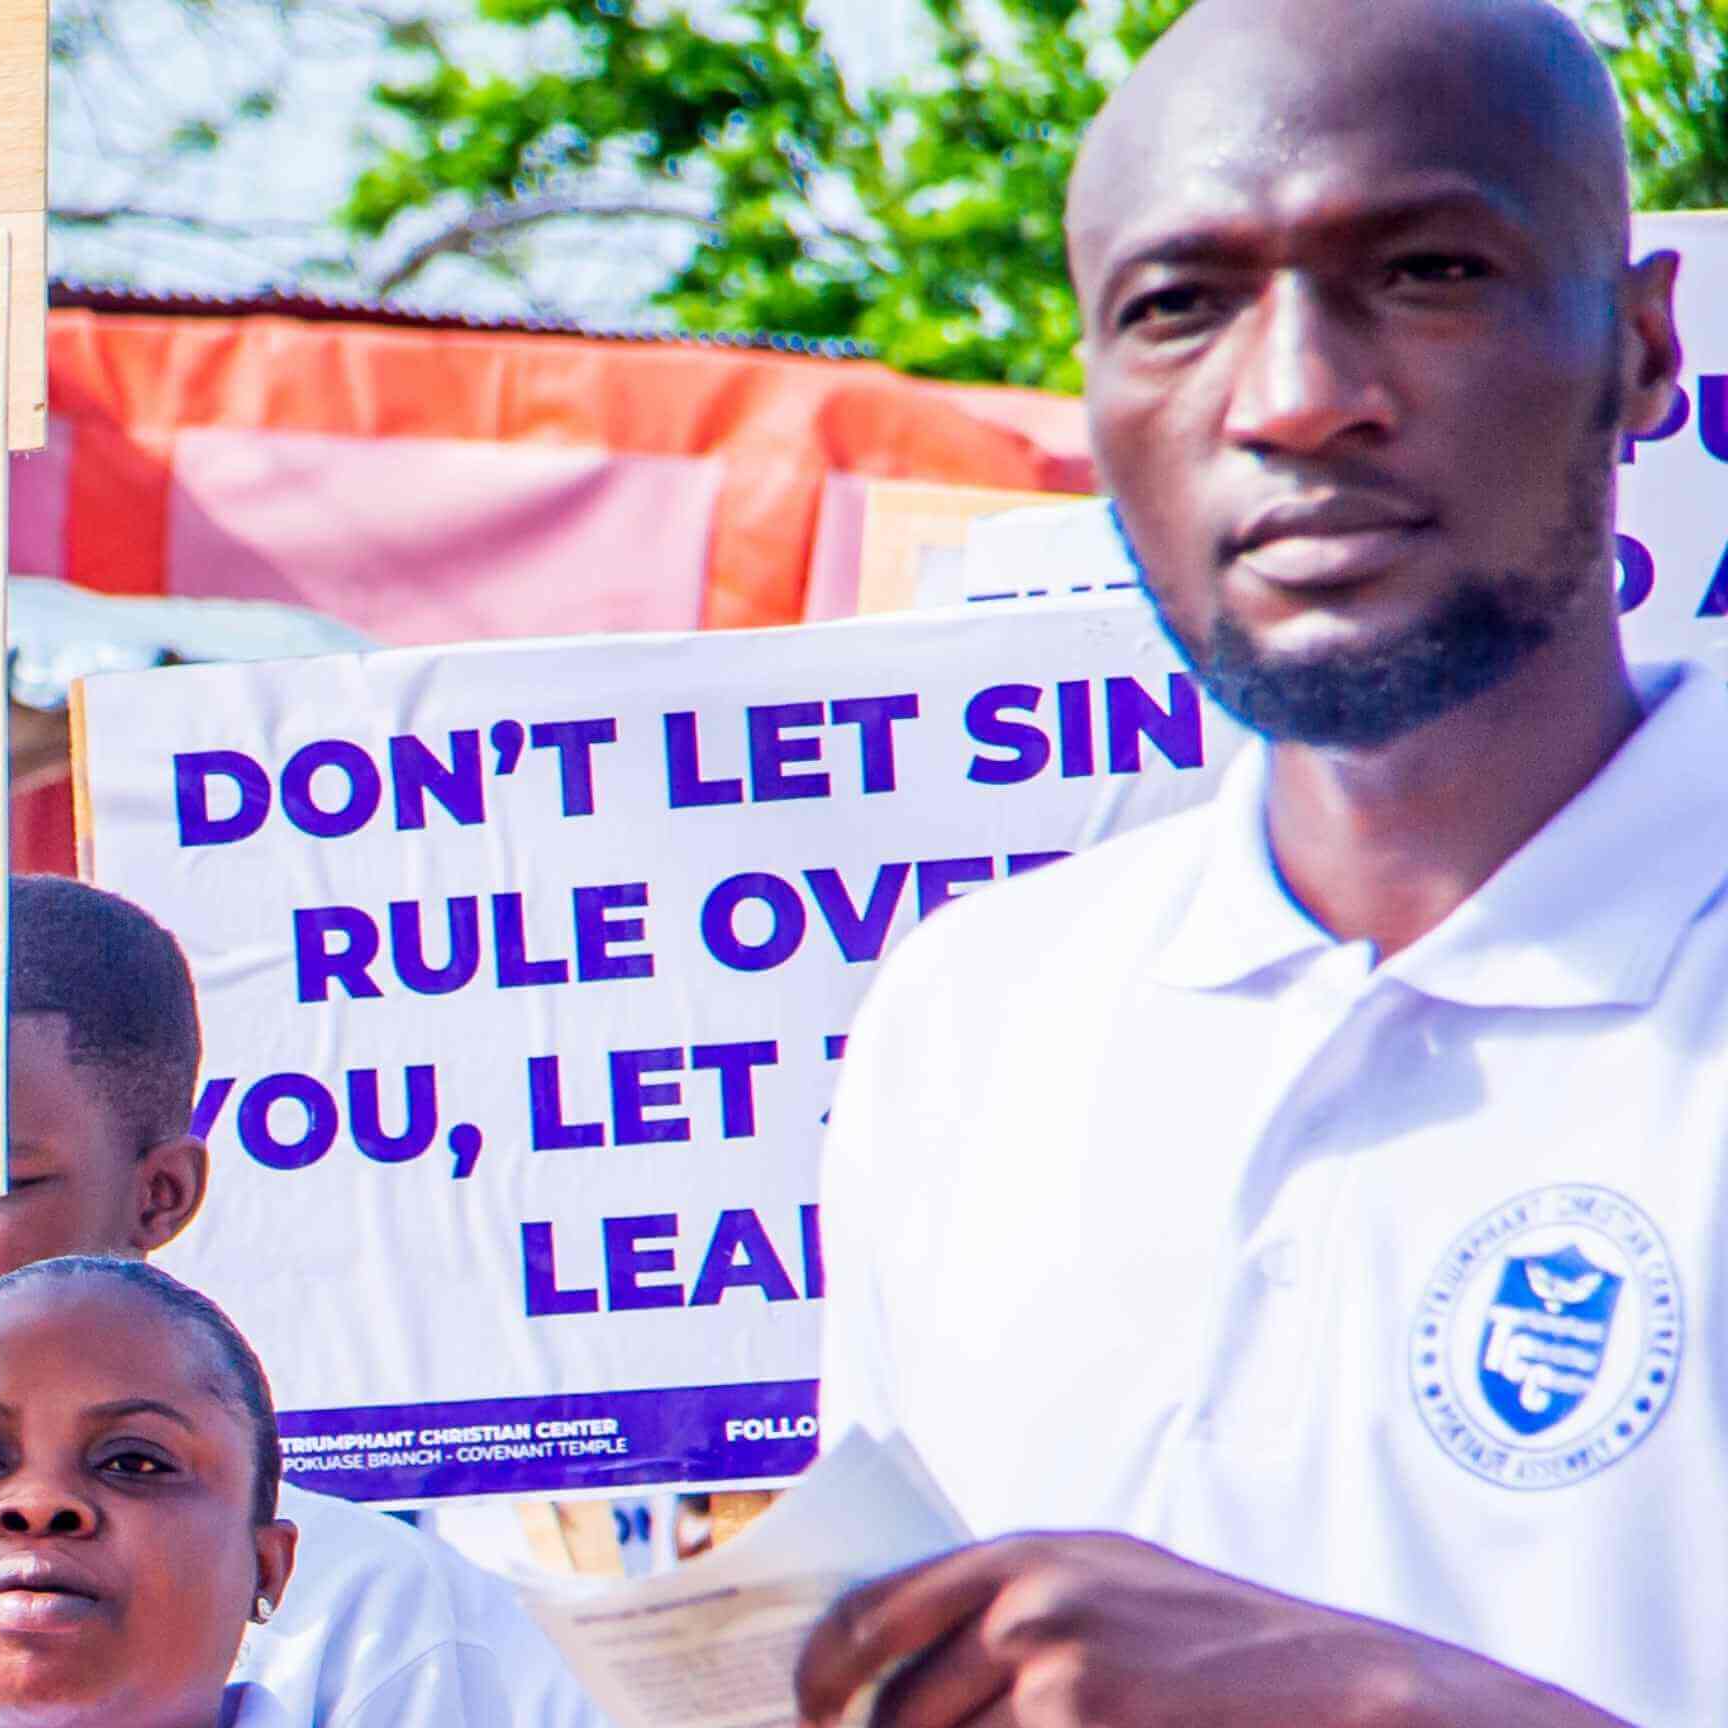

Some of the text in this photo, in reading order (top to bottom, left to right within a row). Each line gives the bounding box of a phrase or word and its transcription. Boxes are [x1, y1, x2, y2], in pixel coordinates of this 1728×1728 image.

[174, 672, 1204, 846] DON’T LET SIN
[294, 851, 1076, 1003] RULE OV
[528, 1040, 778, 1151] LET
[520, 1203, 824, 1317] LEA
[279, 1417, 818, 1456] TRIUMPHANT CHRISTIAN CENTER FOLLO
[281, 1452, 365, 1474] POKUASE
[366, 1448, 443, 1469] BRANCH
[456, 1440, 557, 1464] COVENANT
[558, 1437, 629, 1457] TEMPLE
